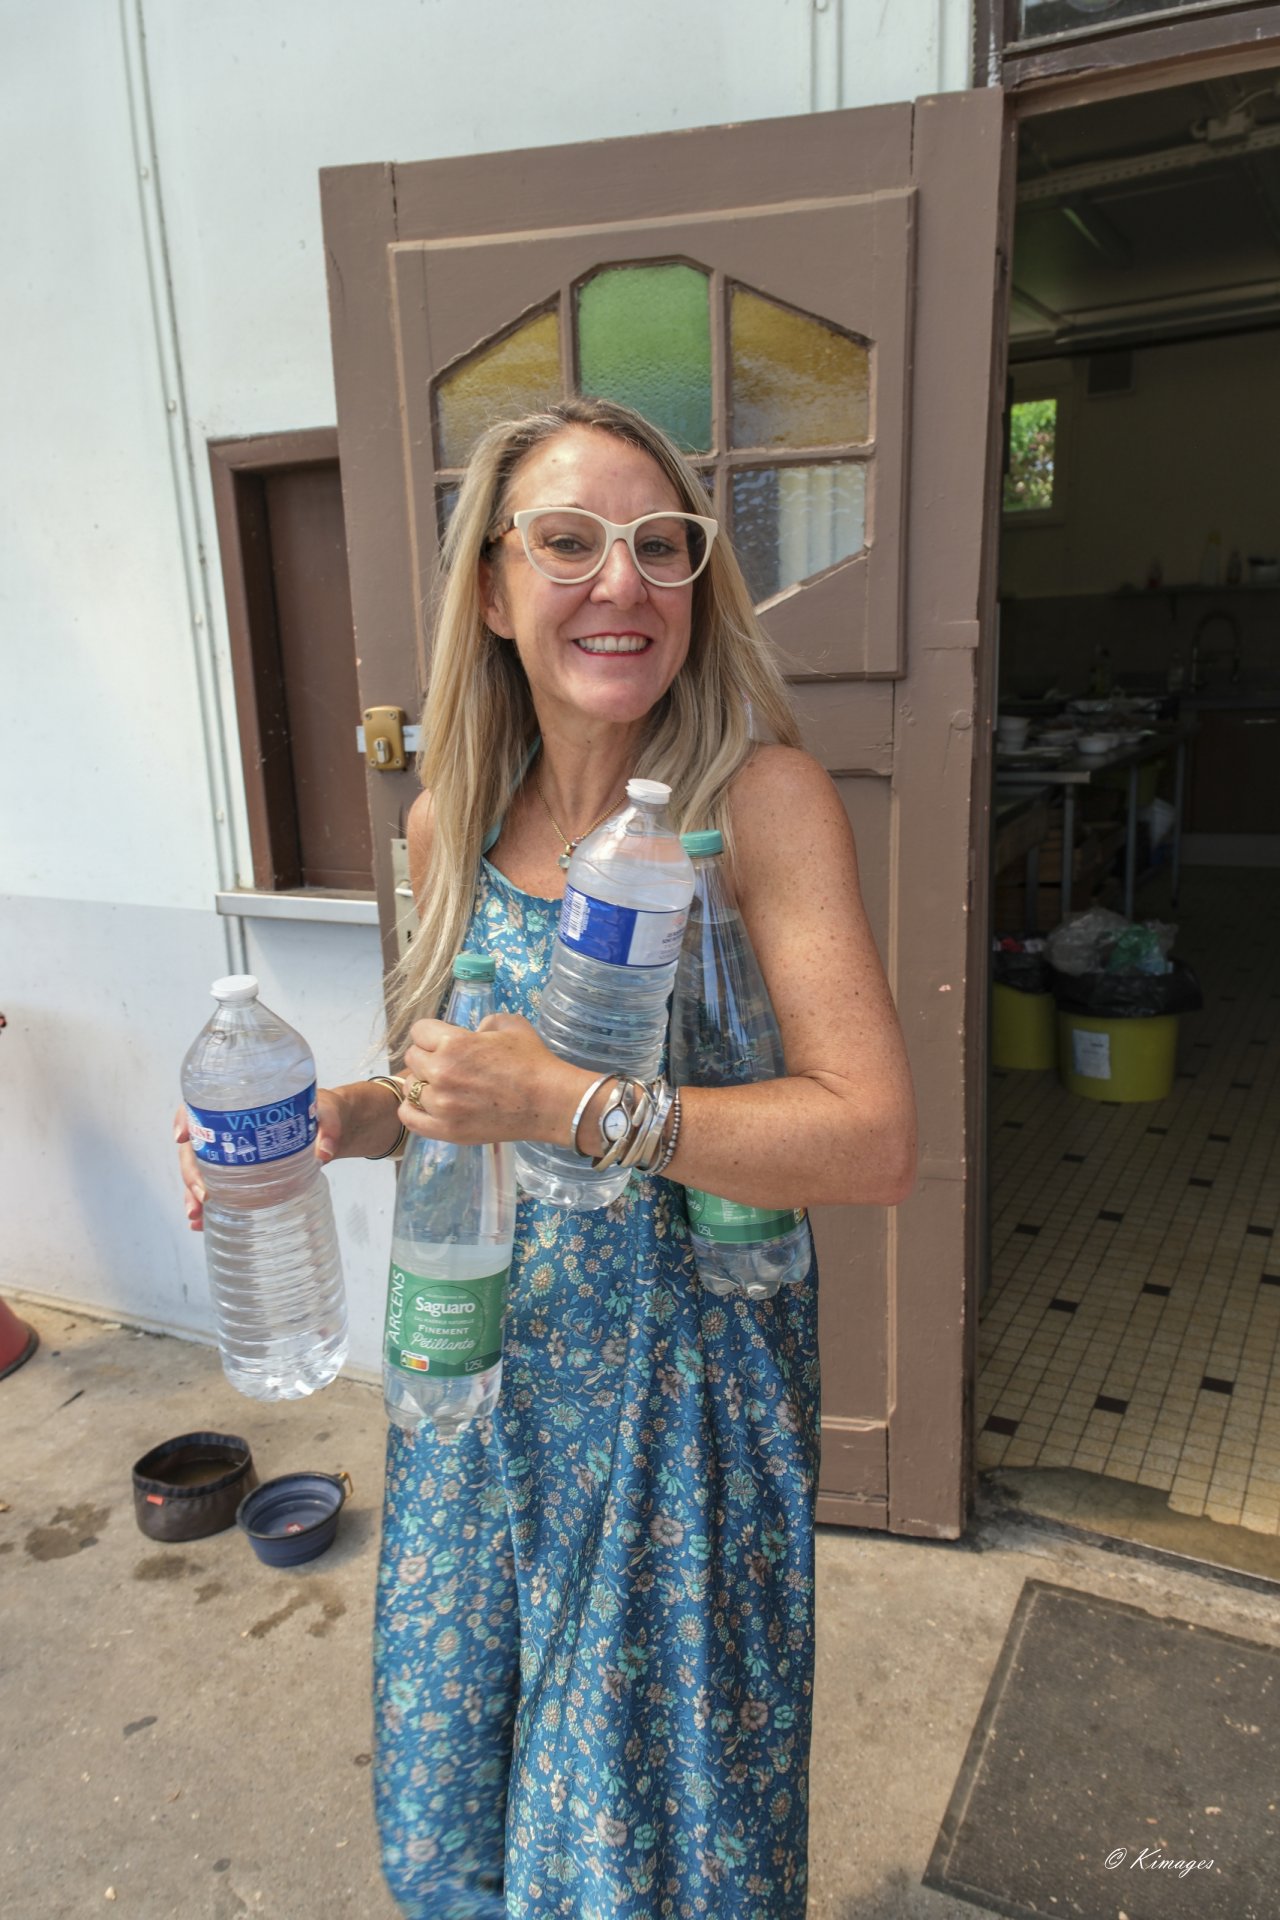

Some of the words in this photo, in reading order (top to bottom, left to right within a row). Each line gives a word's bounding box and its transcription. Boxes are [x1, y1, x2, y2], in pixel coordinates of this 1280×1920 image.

[226, 1102, 295, 1130] VALON
[388, 1269, 405, 1345] ARCENS
[415, 1296, 476, 1317] Saguaro
[418, 1324, 470, 1335] FINEMENT
